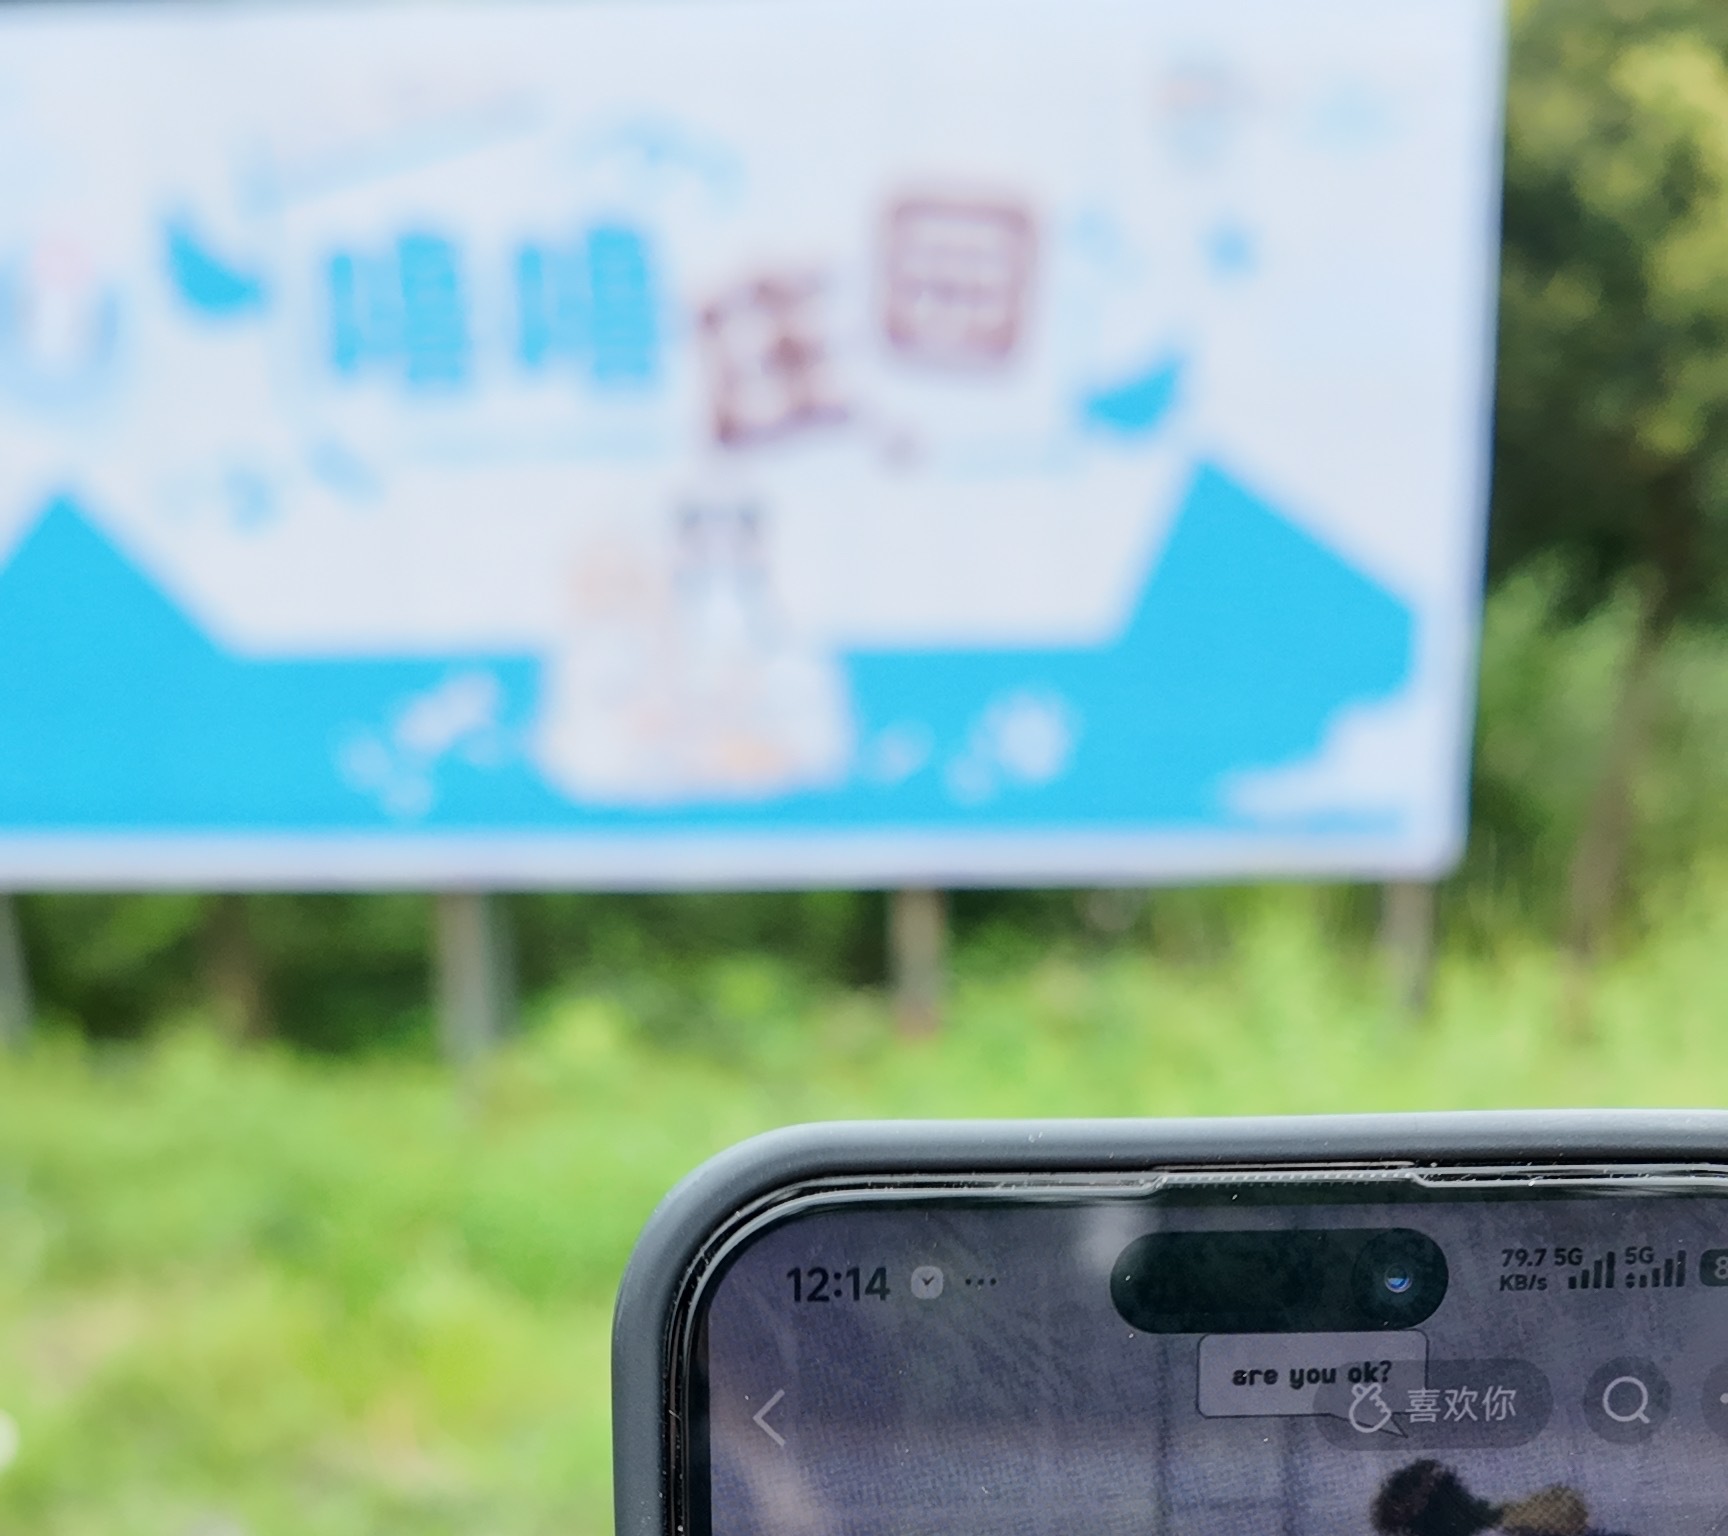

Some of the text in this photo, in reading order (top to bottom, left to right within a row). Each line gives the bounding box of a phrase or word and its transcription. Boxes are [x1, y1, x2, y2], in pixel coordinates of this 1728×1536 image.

[1501, 1248, 1547, 1267] 79.7
[1554, 1248, 1583, 1266] 5G
[1625, 1246, 1654, 1264] 5G
[786, 1266, 890, 1302] 12:14
[1500, 1273, 1548, 1291] KB/s
[1232, 1360, 1392, 1389] are you ok?
[1405, 1385, 1516, 1423] 喜欢你
